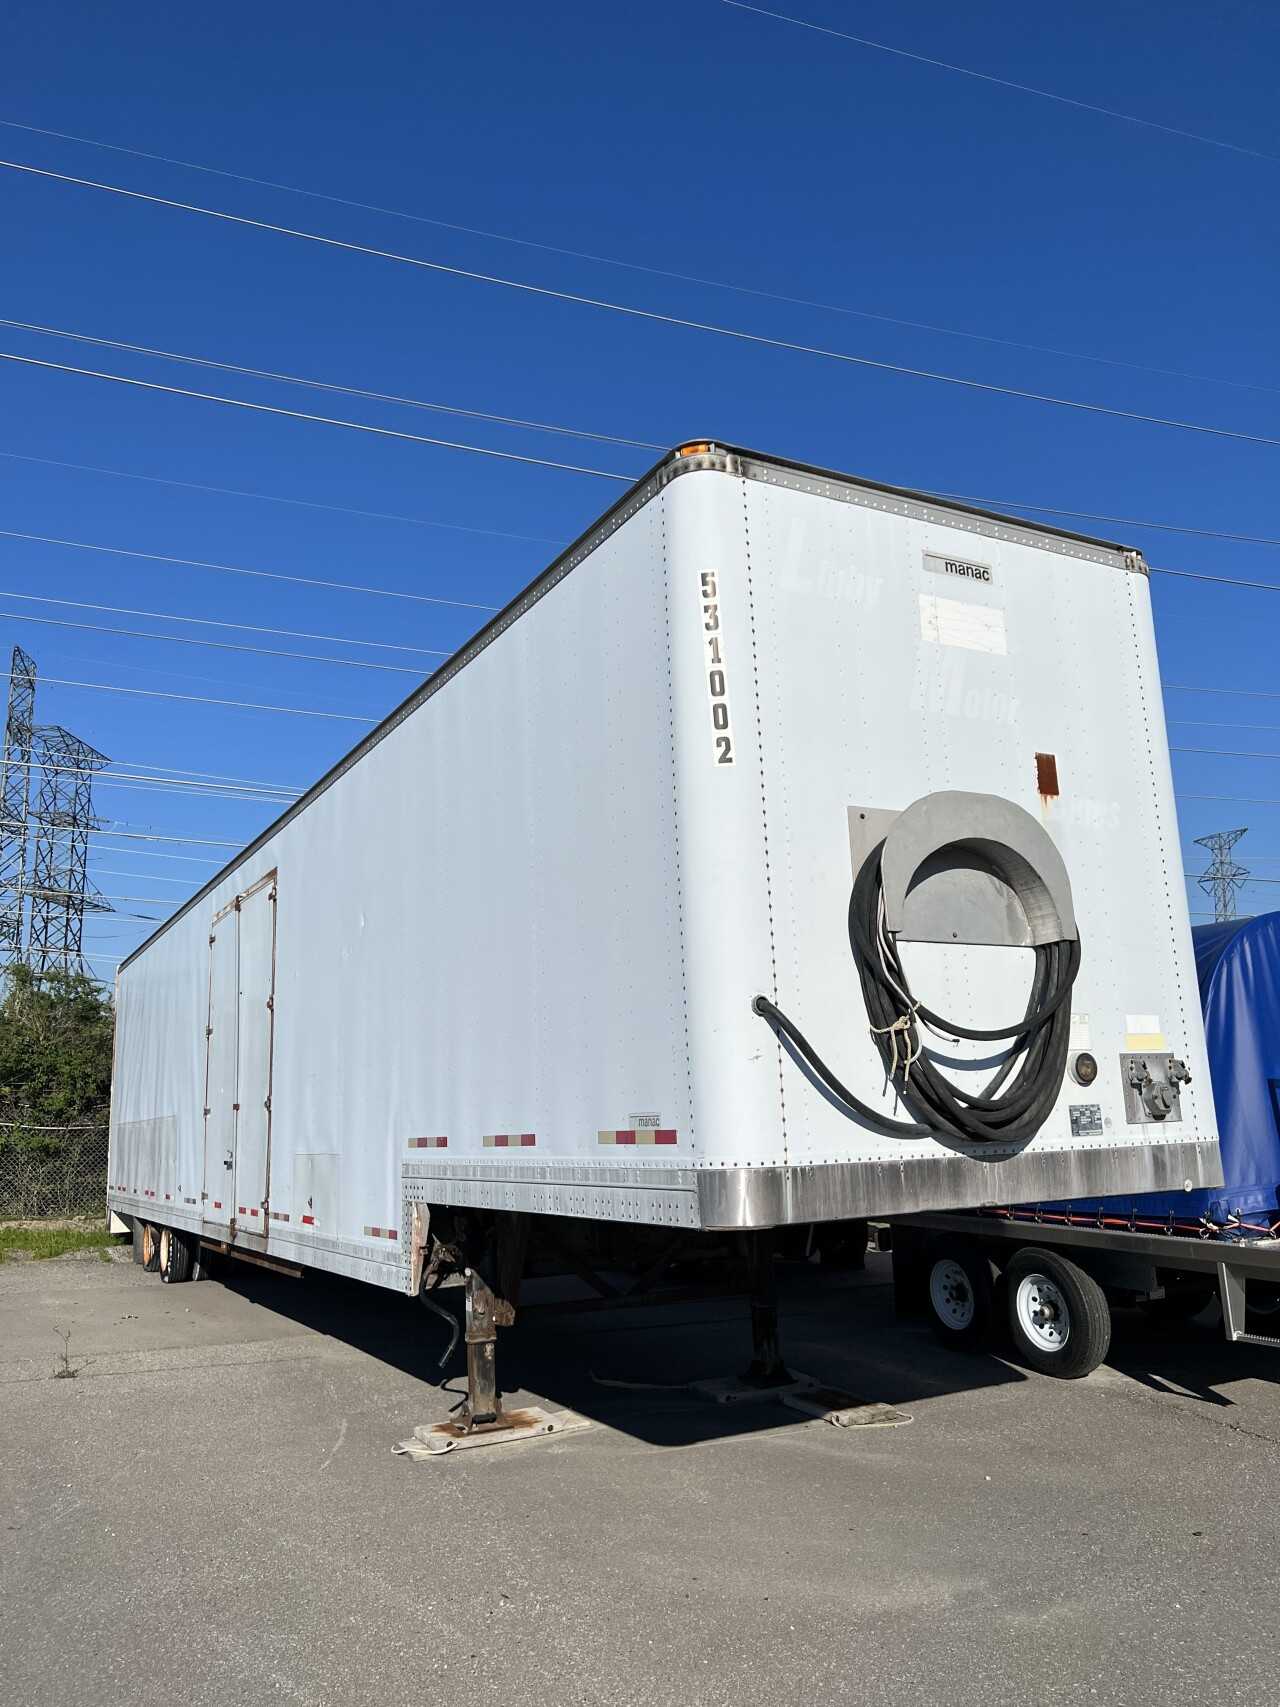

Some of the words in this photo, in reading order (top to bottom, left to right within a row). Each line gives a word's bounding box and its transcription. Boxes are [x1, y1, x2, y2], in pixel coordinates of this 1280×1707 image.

[944, 561, 990, 581] manac
[700, 571, 734, 764] 531002
[638, 1117, 660, 1127] manac
